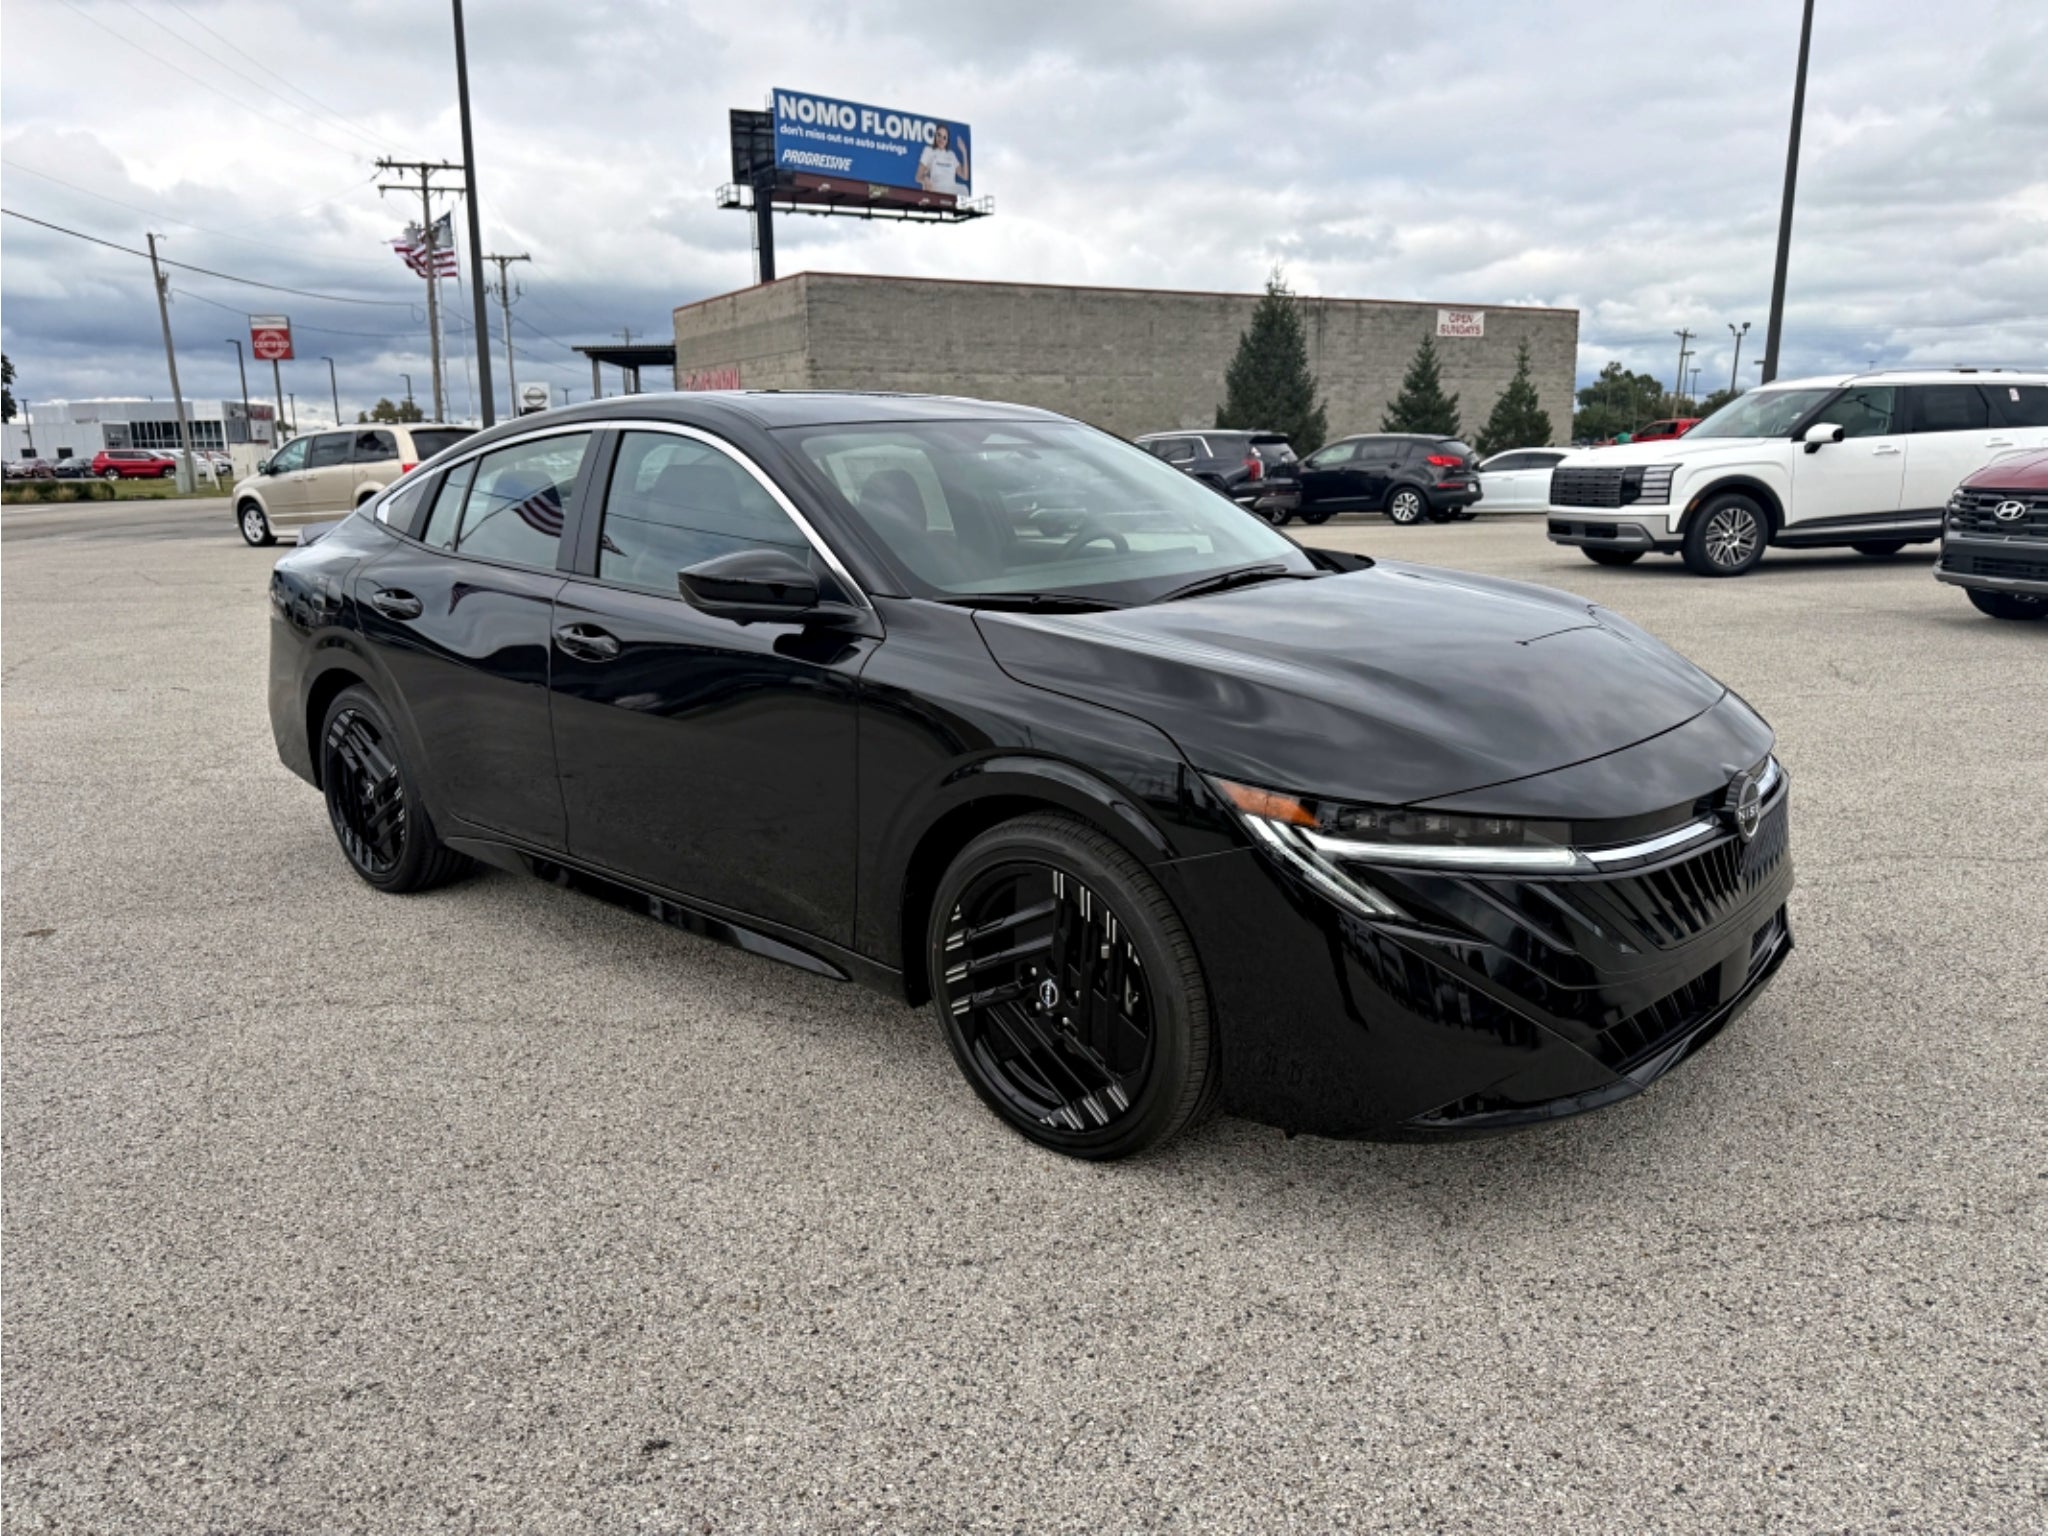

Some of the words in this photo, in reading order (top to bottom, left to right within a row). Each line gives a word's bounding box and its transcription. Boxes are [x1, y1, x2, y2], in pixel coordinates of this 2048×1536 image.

[778, 94, 856, 131] NOMO
[861, 110, 937, 145] FLOMO
[780, 123, 804, 137] don't
[805, 128, 826, 141] miss
[826, 133, 843, 143] out
[855, 138, 875, 149] auto
[876, 142, 908, 156] savings
[782, 148, 853, 172] PROGRESSIVE
[1440, 323, 1482, 335] SUNDAYS
[1449, 312, 1473, 323] OPEN
